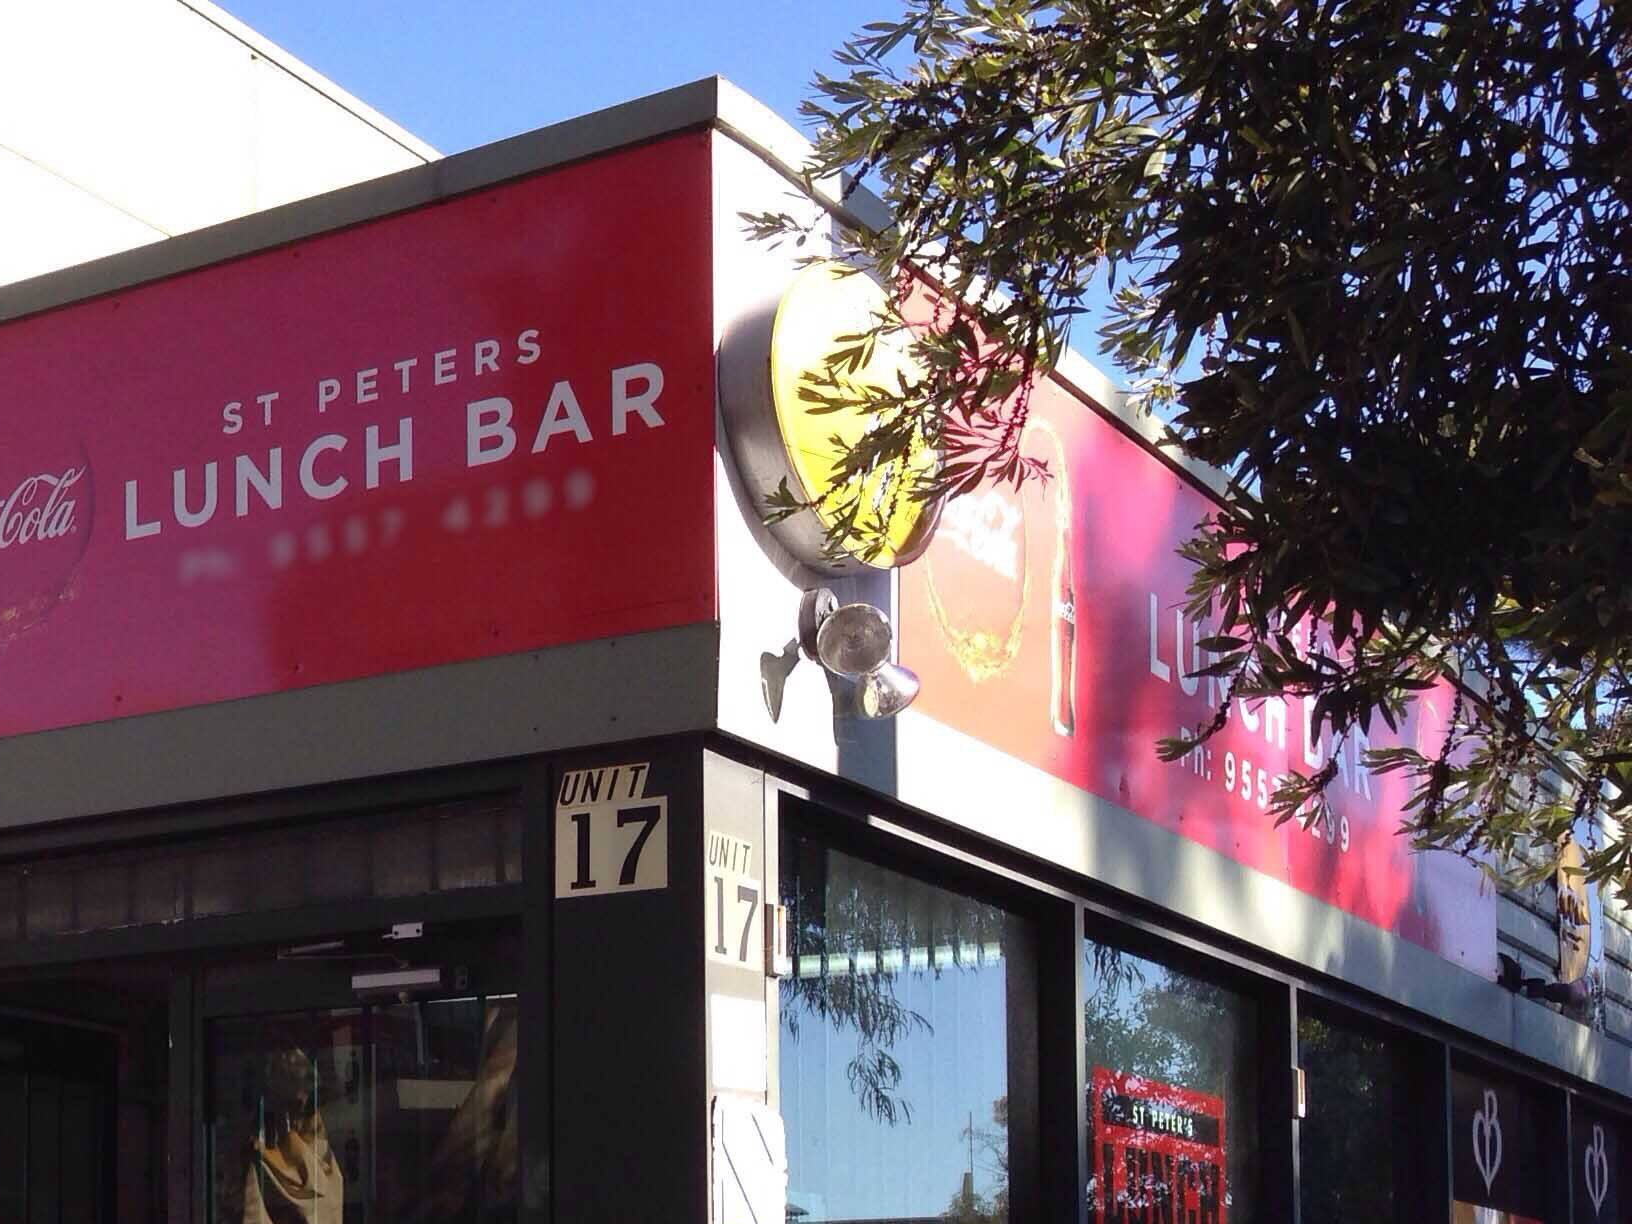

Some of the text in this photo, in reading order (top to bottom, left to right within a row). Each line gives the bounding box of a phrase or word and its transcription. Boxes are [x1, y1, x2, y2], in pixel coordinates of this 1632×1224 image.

[222, 329, 541, 434] ST PETERS
[125, 416, 413, 541] LUNCH
[466, 362, 666, 467] BAR
[559, 765, 647, 806] UNIT
[571, 805, 661, 890] 17
[708, 834, 751, 875] UNIT
[714, 876, 758, 962] 17
[1132, 1105, 1145, 1125] ST
